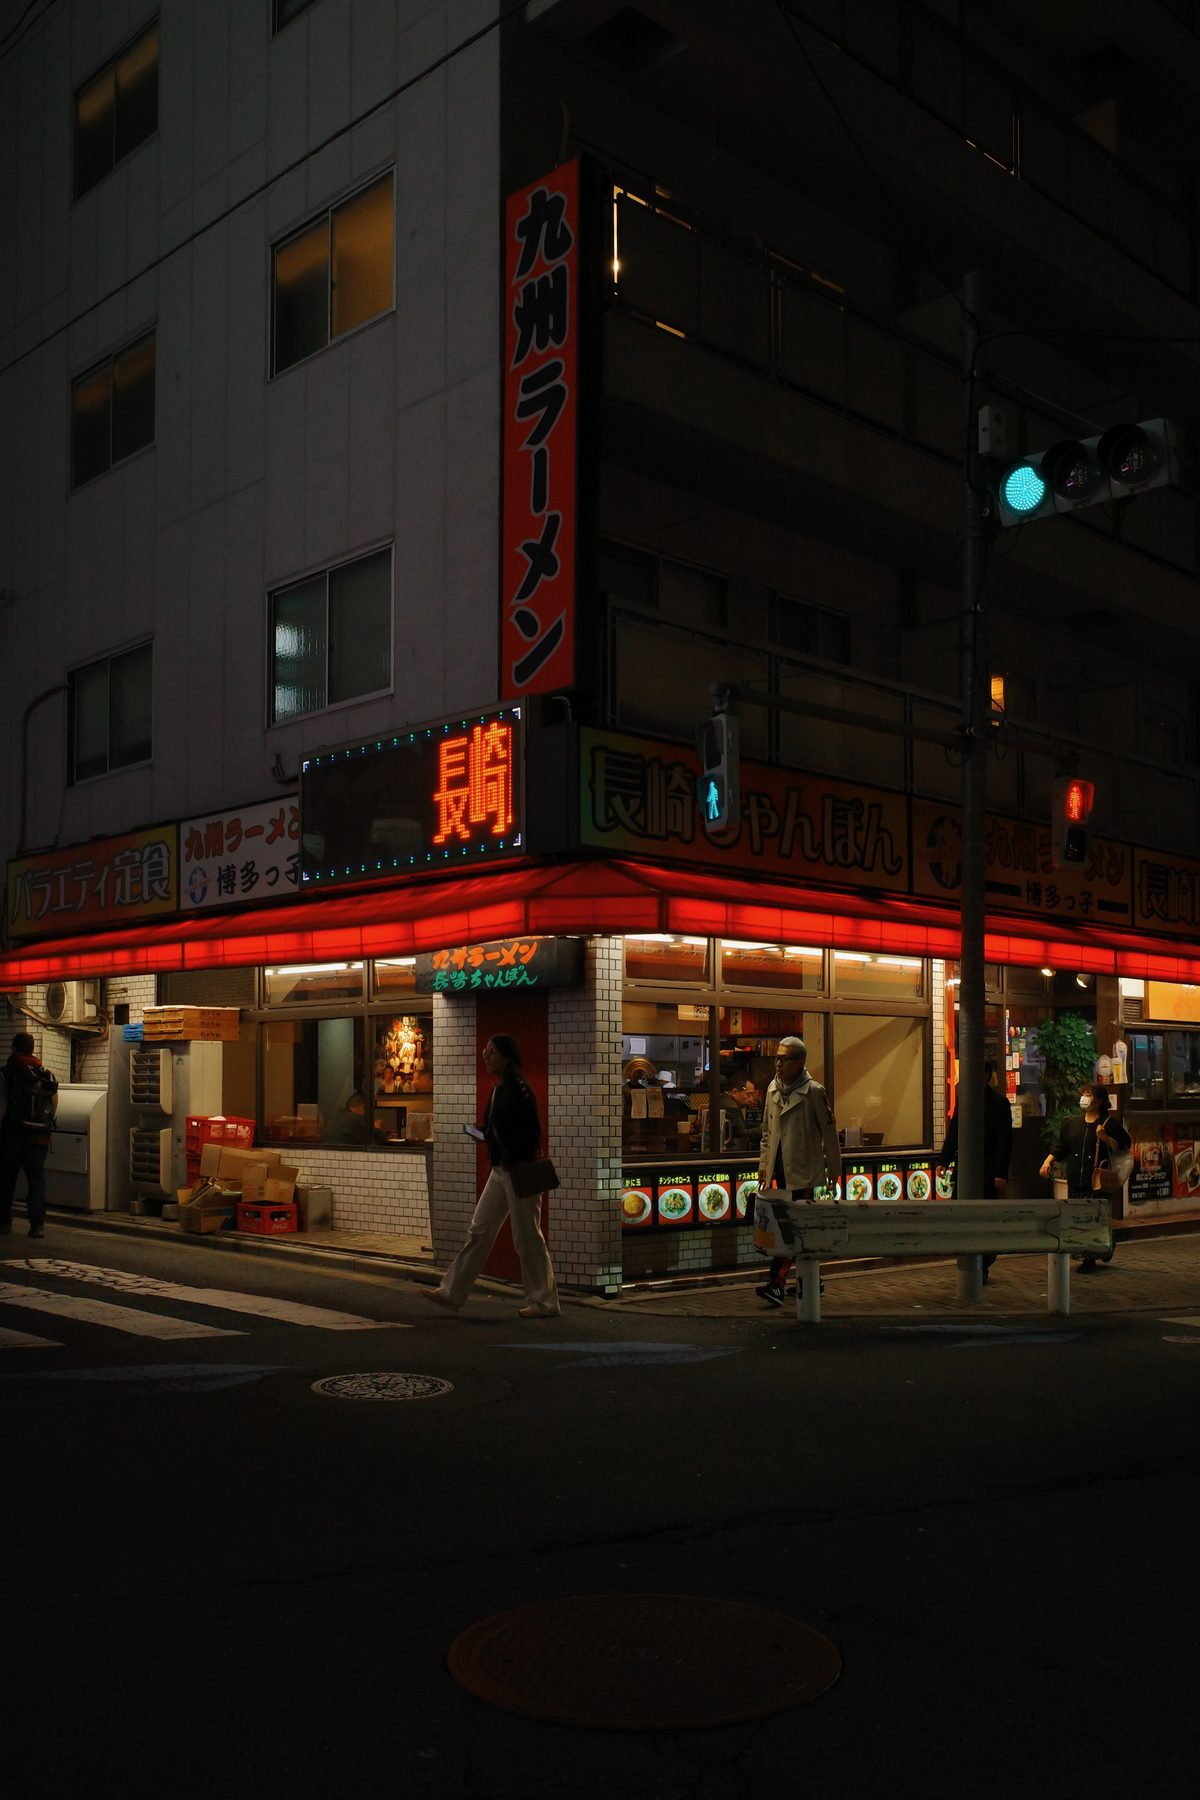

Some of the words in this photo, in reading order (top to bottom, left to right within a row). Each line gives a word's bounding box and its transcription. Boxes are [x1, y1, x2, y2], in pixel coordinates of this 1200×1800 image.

[510, 187, 573, 686] 九州ラーメン
[432, 721, 514, 846] 長崎
[9, 840, 173, 925] バラエティ定食
[1025, 879, 1096, 914] 博多っ子
[432, 965, 539, 991] 長崎ちゃんぽん
